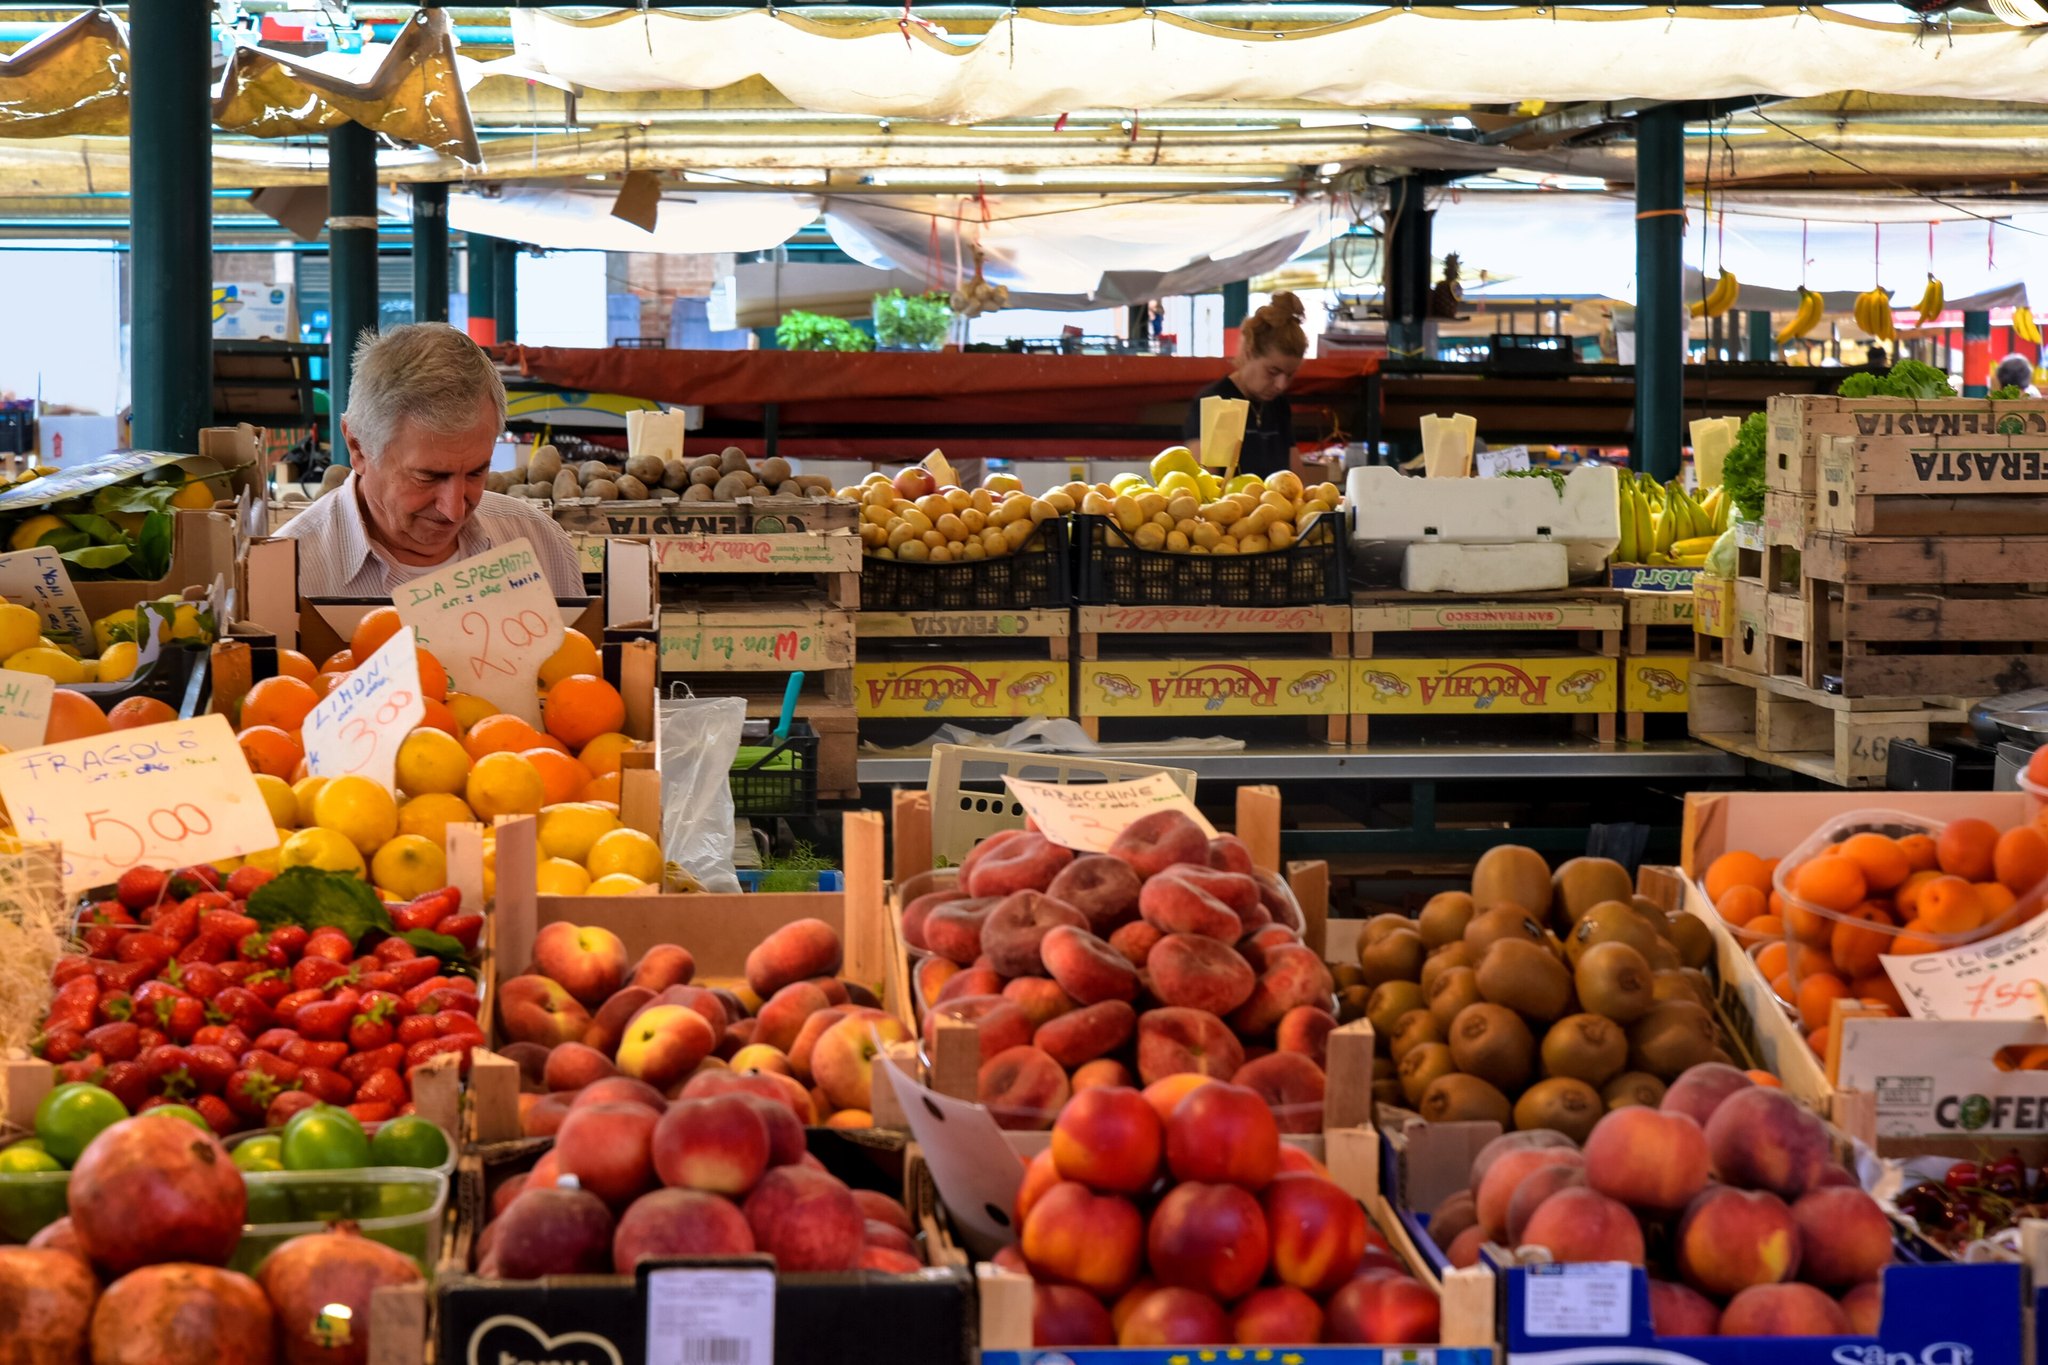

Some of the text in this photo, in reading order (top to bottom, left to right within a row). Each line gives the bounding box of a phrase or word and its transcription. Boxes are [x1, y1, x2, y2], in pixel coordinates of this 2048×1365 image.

[408, 551, 533, 606] DA SPREMUTA
[1445, 611, 1554, 622] SAN FRANCESCO
[866, 664, 1001, 709] RECCHIA
[1147, 663, 1282, 707] RECCHIA
[1417, 662, 1551, 706] RECCHIA
